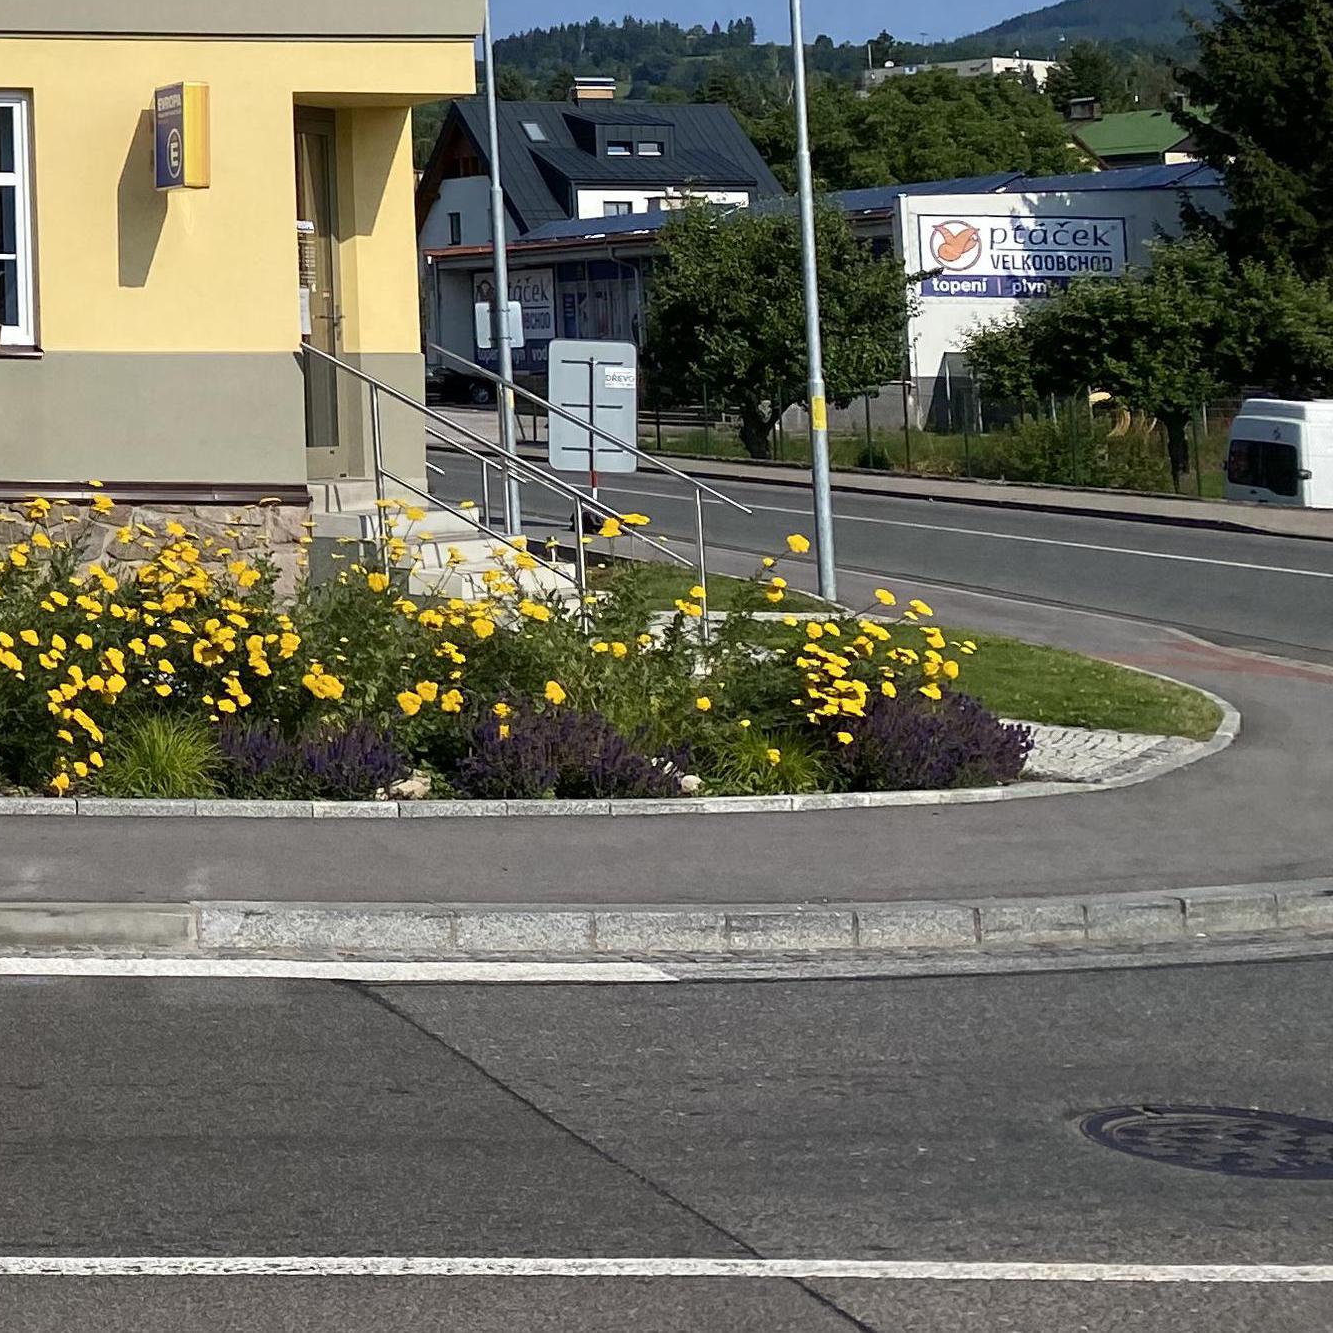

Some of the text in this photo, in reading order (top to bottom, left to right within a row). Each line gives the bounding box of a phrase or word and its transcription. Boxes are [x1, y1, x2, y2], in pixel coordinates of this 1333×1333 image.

[990, 221, 1111, 250] ptáček
[990, 254, 1113, 272] VELKOOBCHOD
[507, 275, 549, 303] táček
[932, 277, 988, 294] topení
